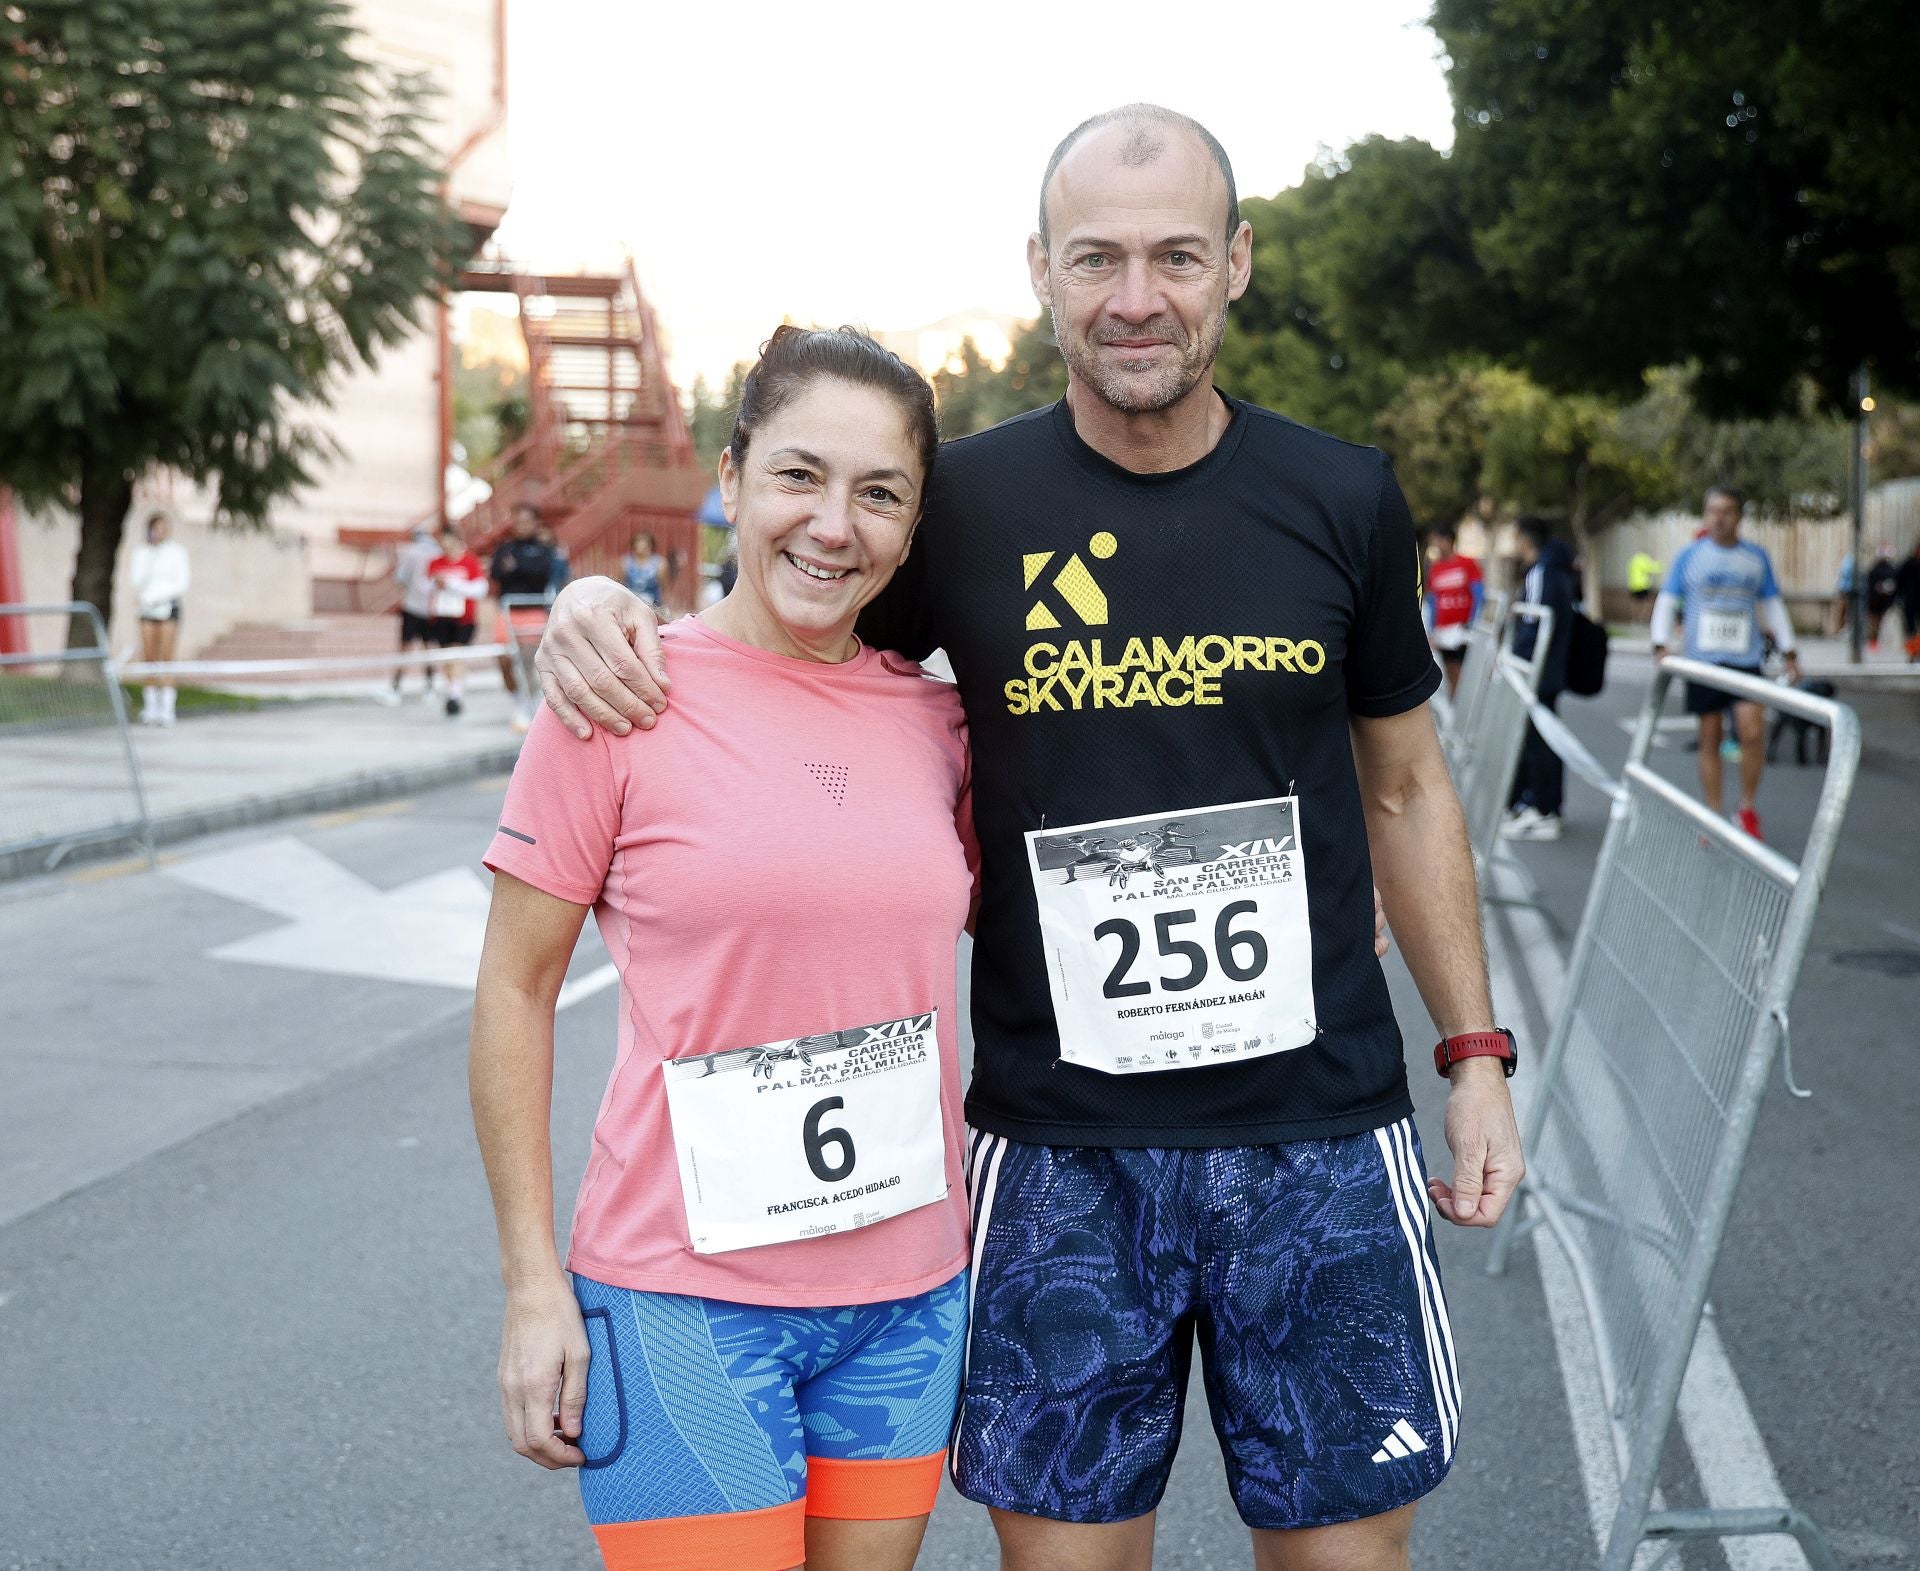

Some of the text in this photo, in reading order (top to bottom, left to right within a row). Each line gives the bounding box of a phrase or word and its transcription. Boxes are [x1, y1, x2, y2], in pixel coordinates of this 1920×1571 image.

[1023, 635, 1326, 678] CALAMORRO
[1003, 669, 1224, 715] SKYRACE
[1214, 835, 1294, 860] XIV
[1154, 862, 1291, 888] SAN SILVESTRE
[1202, 853, 1291, 873] CARRERA
[1113, 871, 1292, 902] PALMA PALMILLA
[1207, 885, 1240, 894] CIUDAD
[1093, 900, 1268, 999] 256
[1117, 989, 1266, 1019] ROBERTO FERNÁNDEZ MAGÁN
[860, 1015, 931, 1044] XIV
[801, 1043, 925, 1076] SAN SILVESTRE
[849, 1034, 924, 1058] CARRERA
[757, 1051, 927, 1093] PALMA PALMILLA
[853, 1069, 882, 1080] CIUDAD
[803, 1095, 856, 1182] 6
[767, 1175, 901, 1216] FRANCISCA ACEDO HIDALGO
